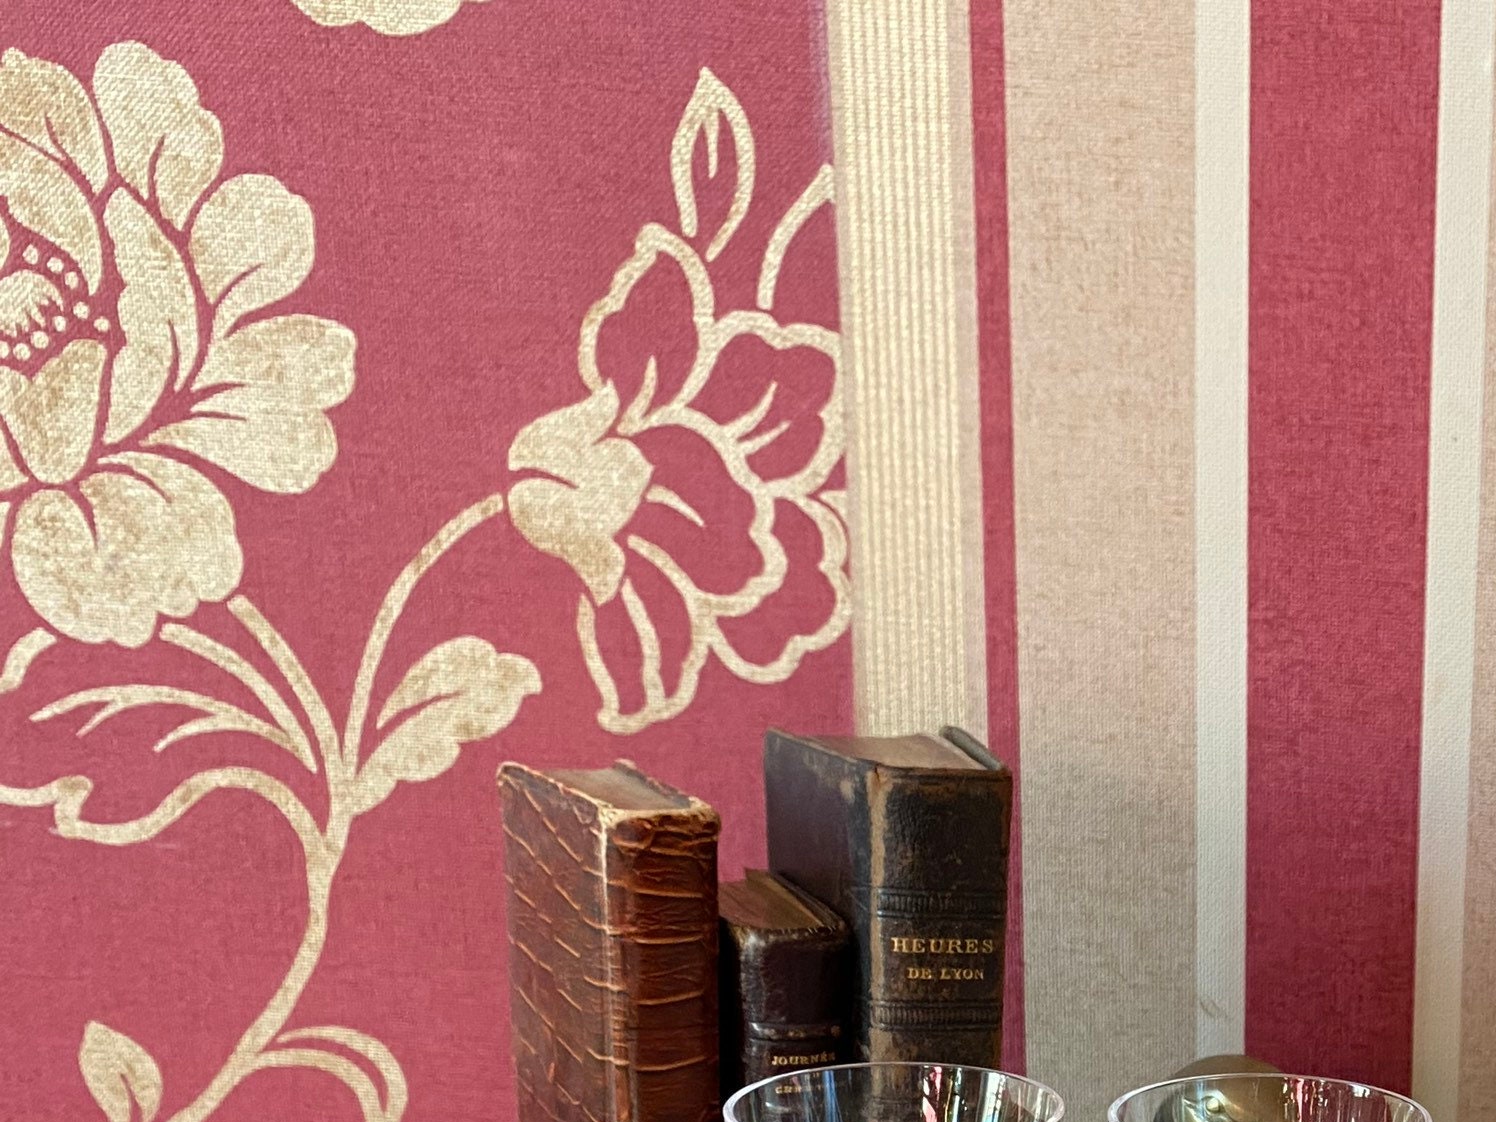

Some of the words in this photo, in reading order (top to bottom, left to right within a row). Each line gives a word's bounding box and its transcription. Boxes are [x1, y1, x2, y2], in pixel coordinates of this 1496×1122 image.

[890, 937, 993, 954] HEURES
[907, 967, 932, 980] DE
[940, 967, 984, 980] LYON
